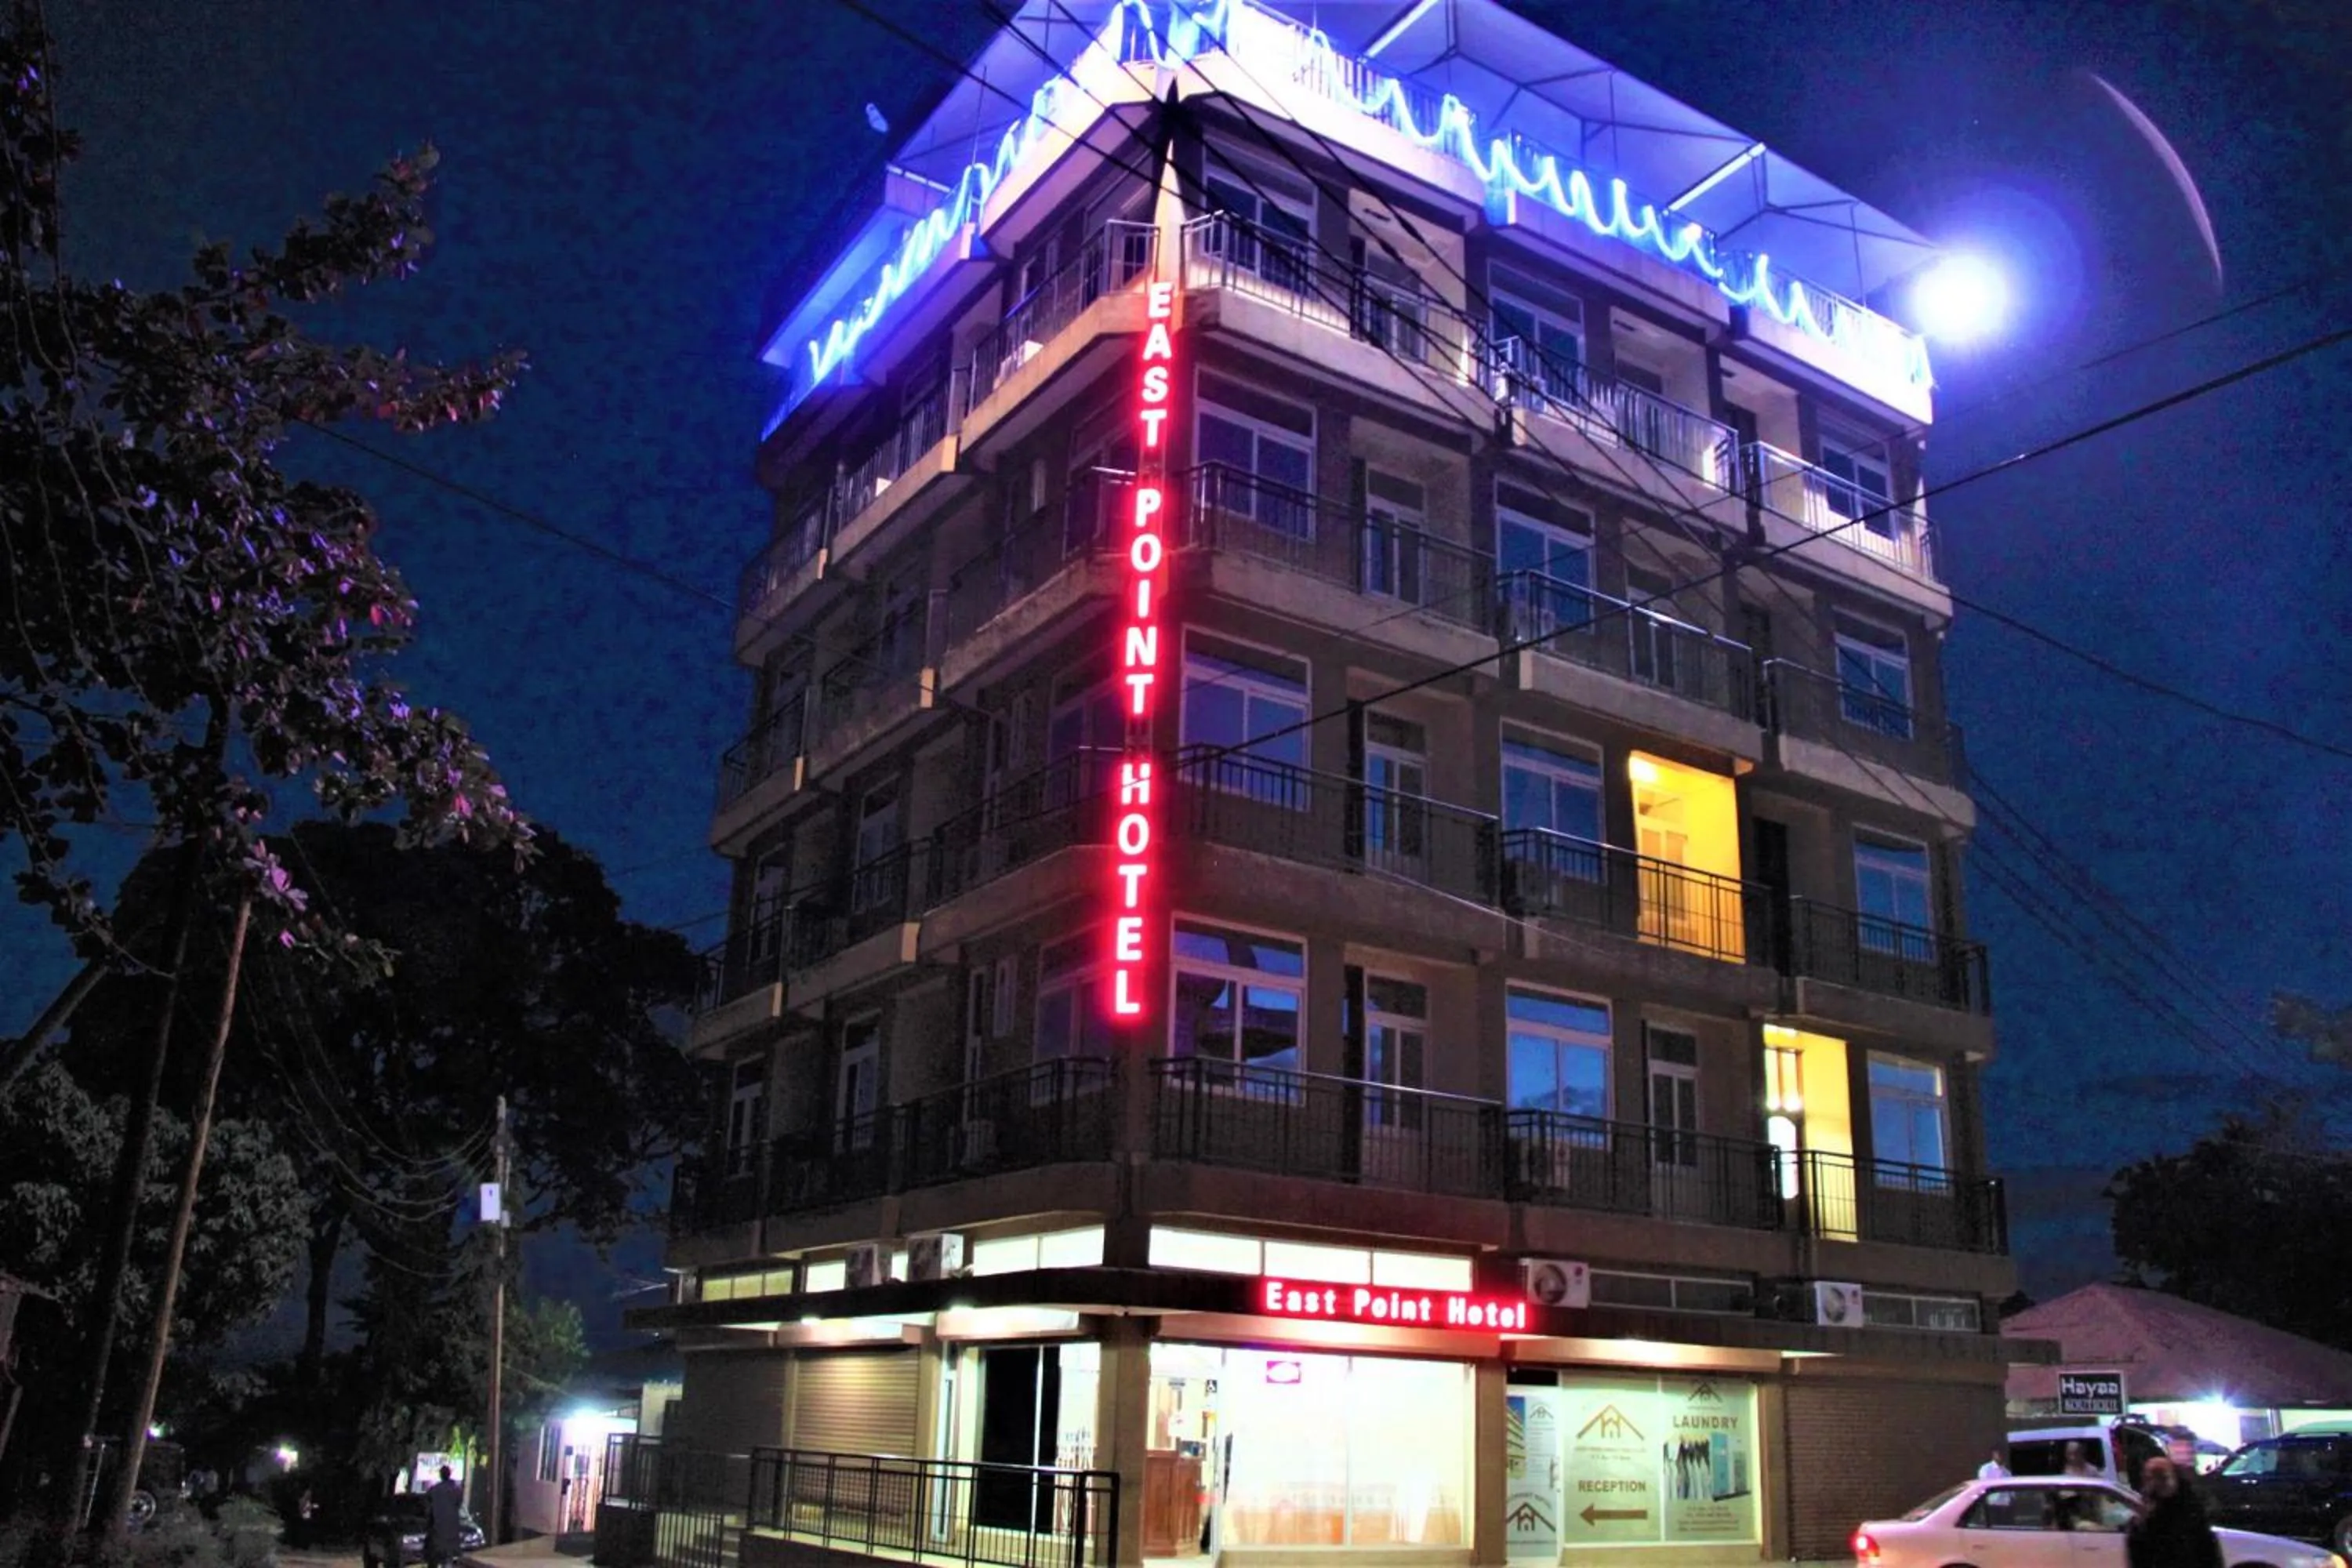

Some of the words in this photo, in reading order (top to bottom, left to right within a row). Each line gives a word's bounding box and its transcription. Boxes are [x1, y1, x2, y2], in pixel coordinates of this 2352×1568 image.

[1140, 282, 1174, 447] EAST
[1125, 488, 1163, 714] POINT
[1115, 763, 1151, 1014] HOTEL
[1265, 1281, 1337, 1315] East
[1353, 1288, 1432, 1322] Point
[1446, 1296, 1526, 1329] Hotel
[2061, 1377, 2118, 1399] Hayaa
[1672, 1414, 1738, 1429] LAUNDRY
[1577, 1479, 1646, 1493] RECEPTION
